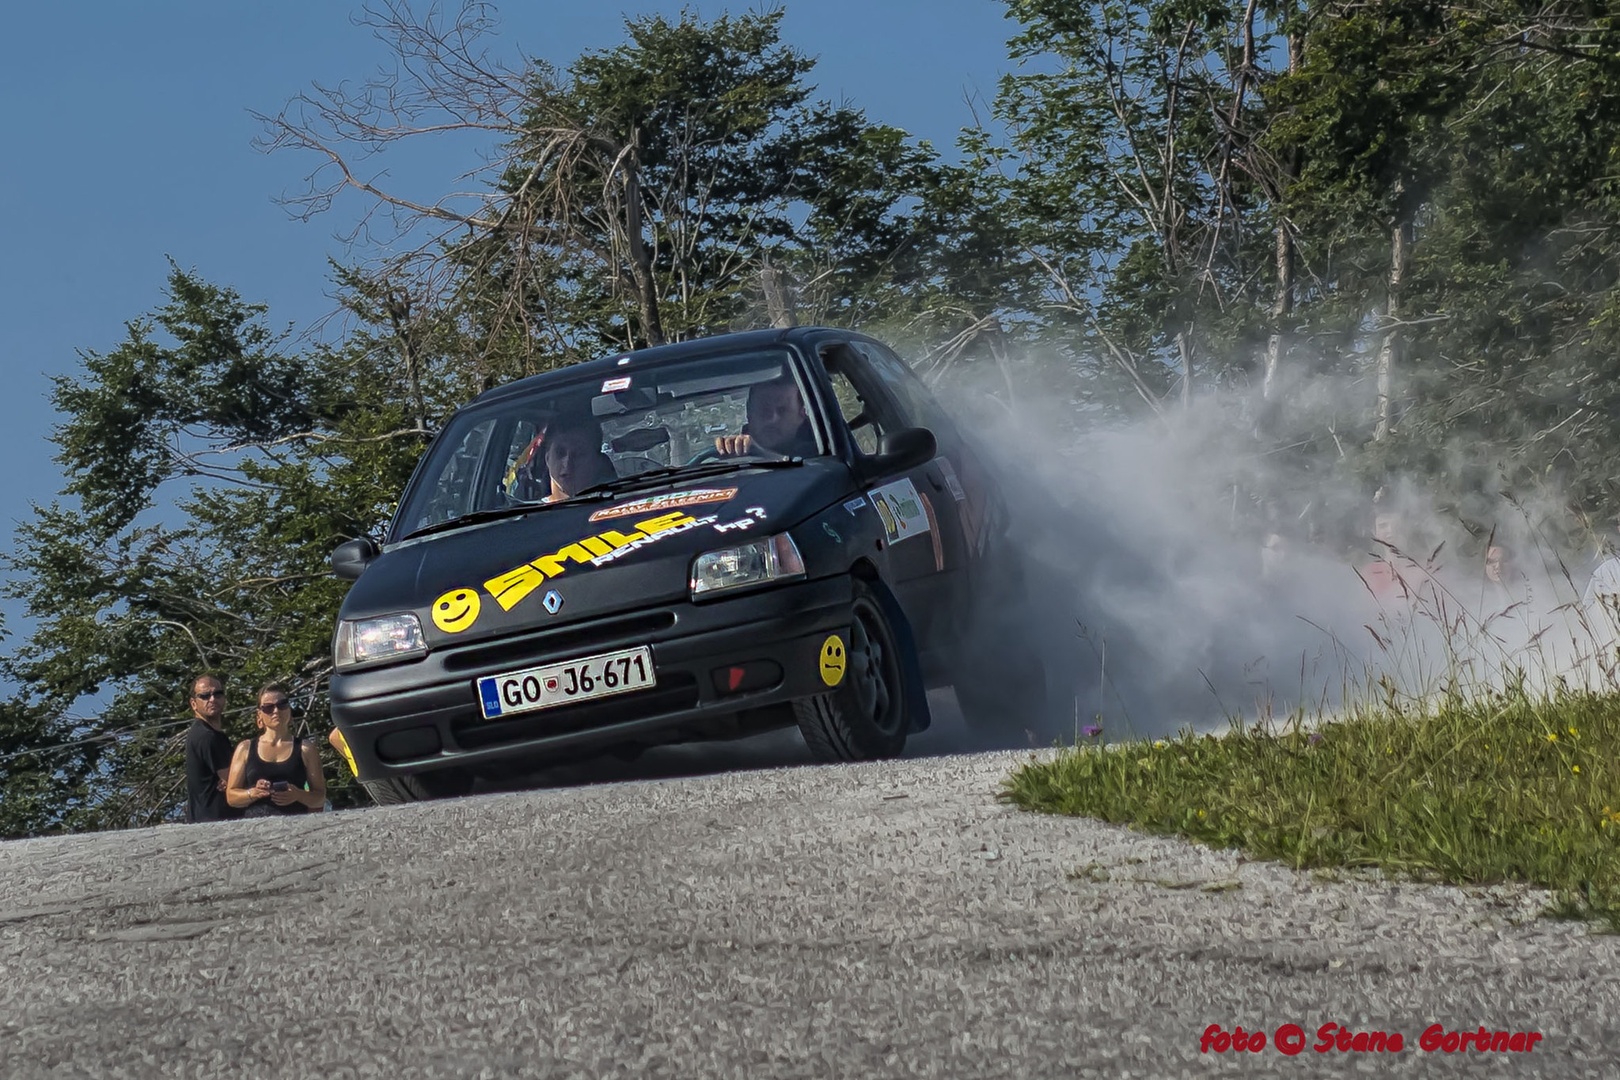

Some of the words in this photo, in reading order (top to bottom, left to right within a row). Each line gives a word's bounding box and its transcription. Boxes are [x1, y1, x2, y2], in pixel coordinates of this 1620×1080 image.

[483, 511, 696, 612] SMILE
[591, 515, 718, 566] RENAULT
[502, 675, 541, 707] GO
